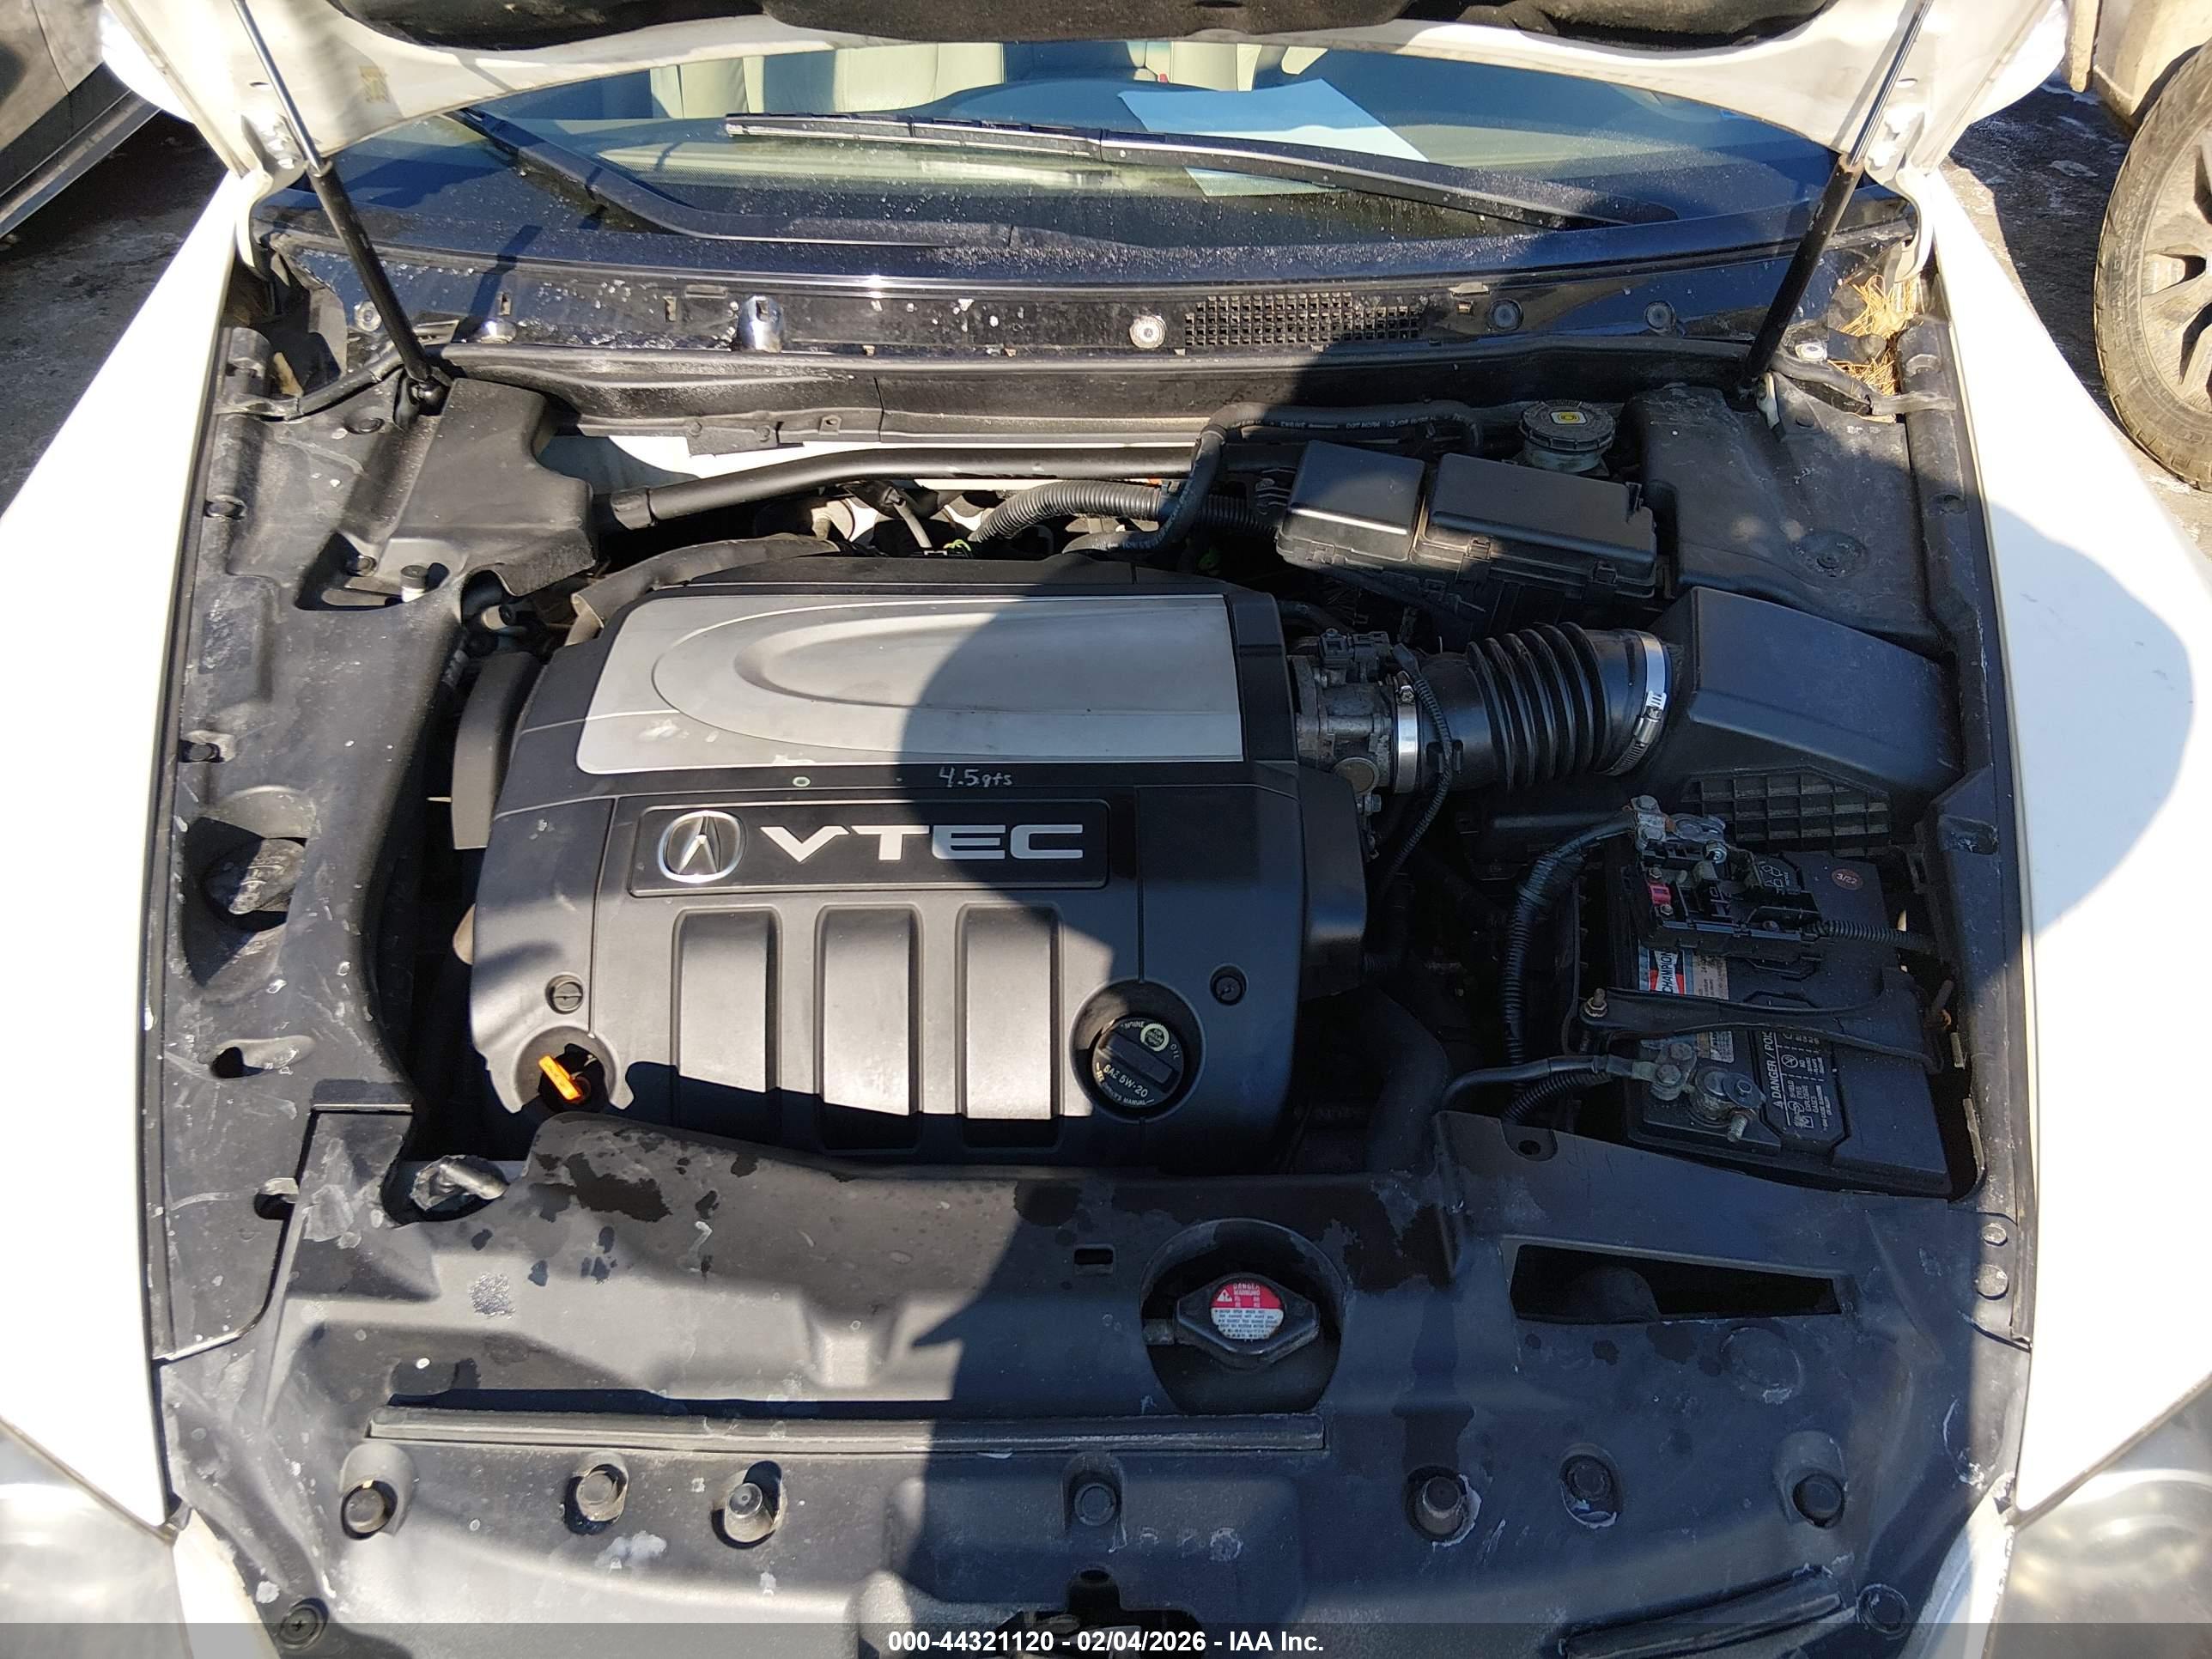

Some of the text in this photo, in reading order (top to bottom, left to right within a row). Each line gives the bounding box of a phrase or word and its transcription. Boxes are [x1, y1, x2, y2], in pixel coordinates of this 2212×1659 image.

[760, 824, 1084, 863] VTEC
[1660, 952, 1674, 994] CHAMPION
[1170, 1043, 1181, 1060] OIL
[1118, 1074, 1148, 1097] 5W-20
[1766, 1060, 1783, 1099] DANGER
